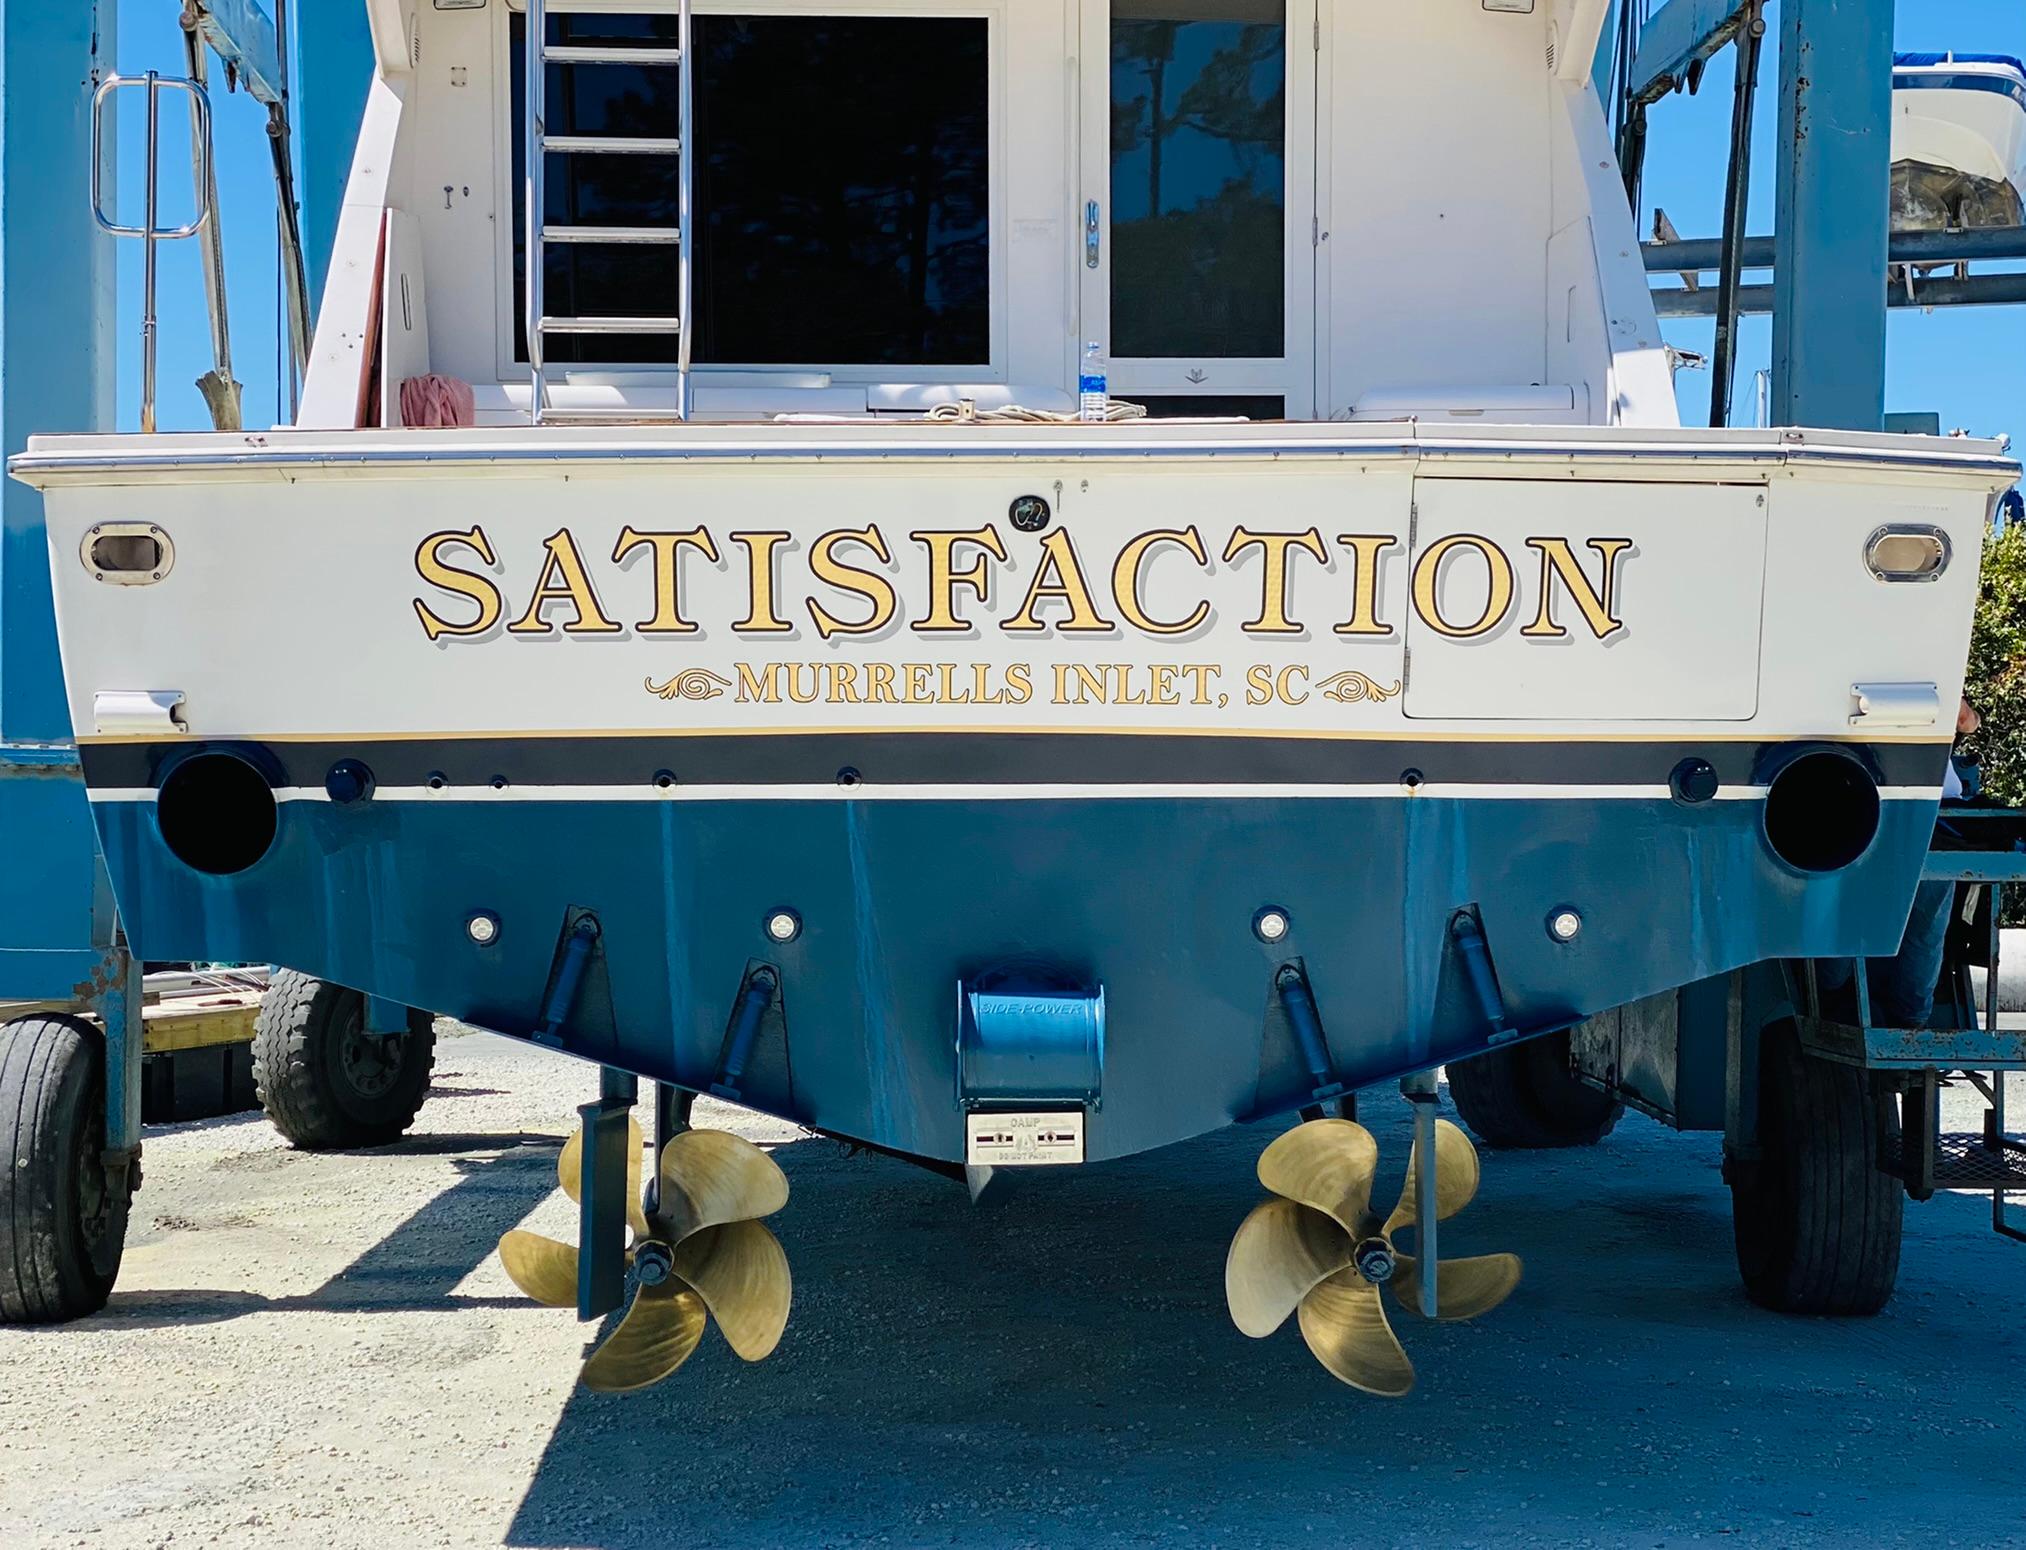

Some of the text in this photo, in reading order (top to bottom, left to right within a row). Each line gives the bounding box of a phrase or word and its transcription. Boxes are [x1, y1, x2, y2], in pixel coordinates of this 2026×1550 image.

[413, 523, 1634, 642] SATISFACTION
[733, 662, 1311, 709] MURRELLS INLET, SC
